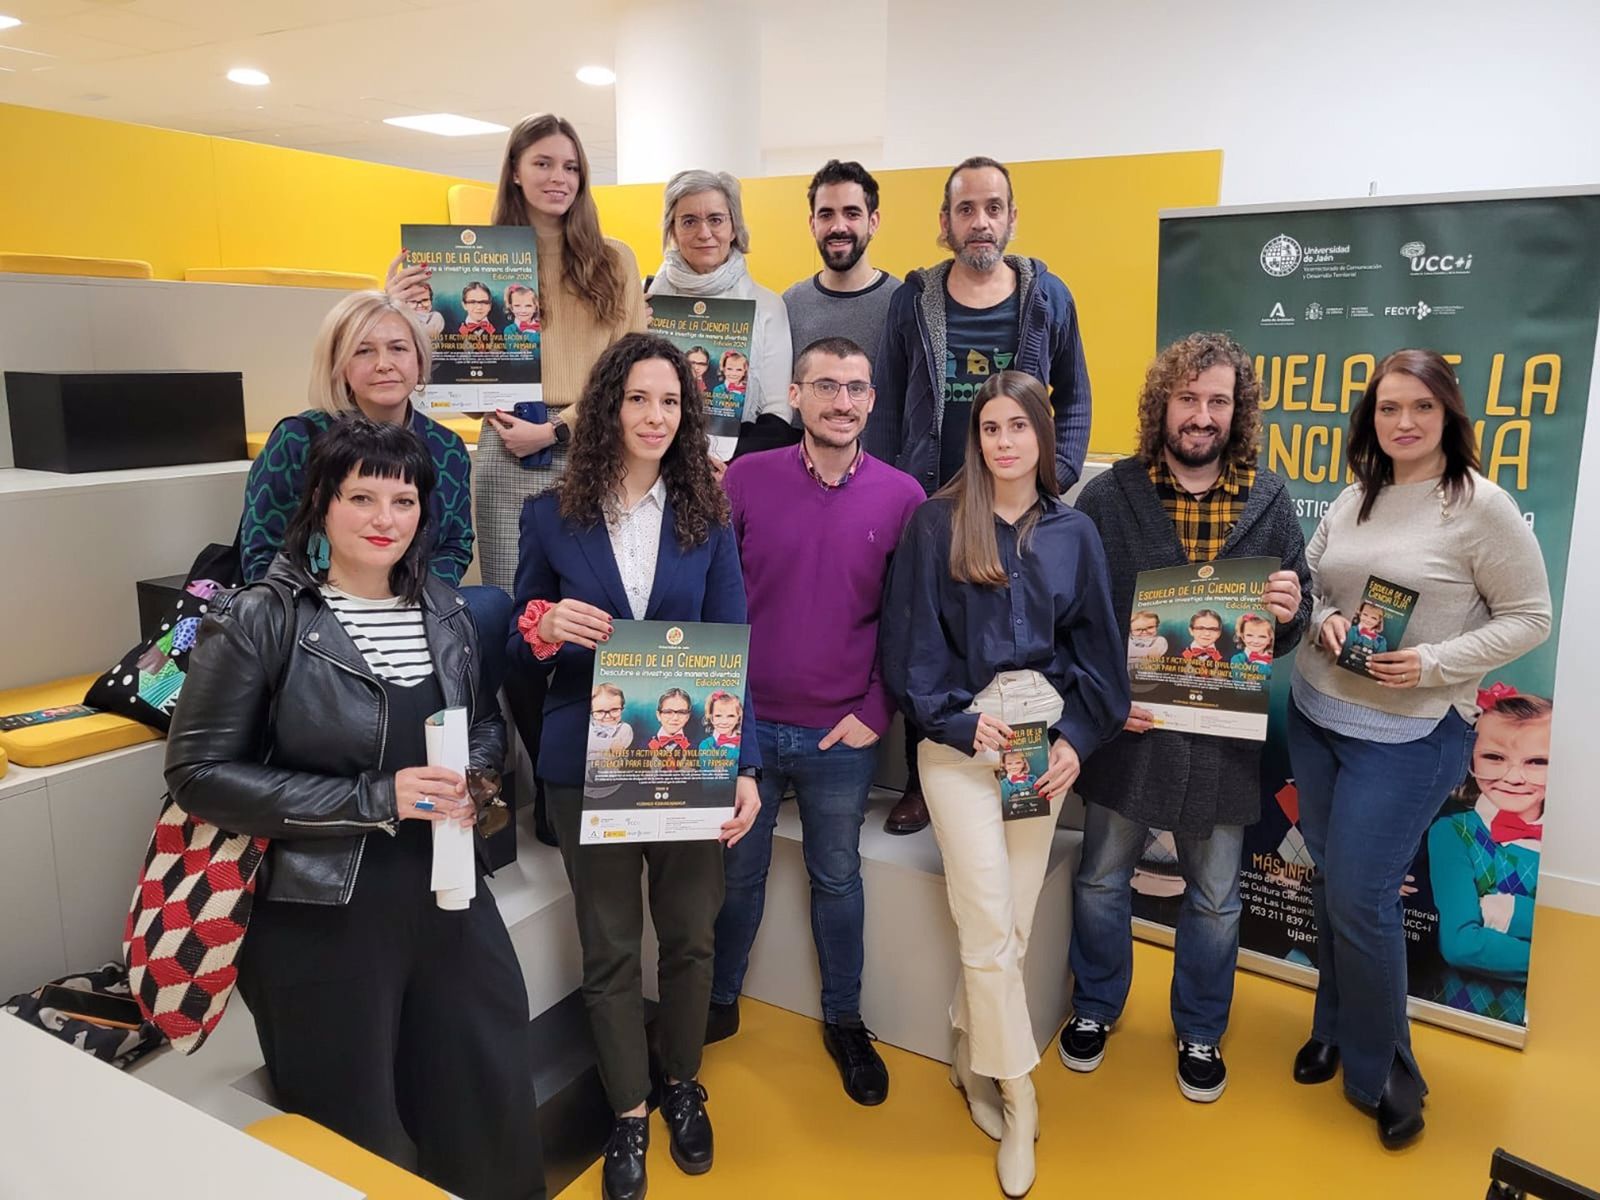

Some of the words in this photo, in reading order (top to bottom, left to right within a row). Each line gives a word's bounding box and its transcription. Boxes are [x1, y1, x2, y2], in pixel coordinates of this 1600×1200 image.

[1304, 244, 1350, 255] Universidad
[445, 252, 456, 264] DE
[459, 252, 471, 264] LA
[473, 251, 508, 265] CIENCIA
[511, 251, 532, 265] UJA
[1303, 255, 1314, 263] de
[1314, 253, 1334, 262] Jaén
[1384, 306, 1418, 316] FECYT
[689, 321, 698, 330] LA
[732, 322, 749, 334] UJA
[1257, 352, 1376, 414] UELA
[1485, 353, 1562, 417] LA
[1138, 587, 1175, 601] ESCUELA
[1178, 586, 1190, 596] DE
[1192, 584, 1205, 595] LA
[1208, 582, 1246, 594] CIENCIA
[1250, 581, 1265, 595] UJ
[601, 650, 642, 667] ESCUELA
[646, 654, 657, 668] DE
[661, 654, 674, 668] LA
[678, 652, 717, 668] CIENCIA
[720, 653, 742, 669] UJA
[600, 668, 634, 676] Descubre
[696, 679, 720, 687] Edición
[1253, 852, 1280, 876] MÁS
[1240, 880, 1249, 889] de
[1251, 883, 1280, 896] Cultura
[1282, 891, 1313, 906] Científic
[1240, 870, 1263, 880] orado
[1264, 876, 1274, 884] de
[1276, 879, 1313, 894] Comunic
[1403, 908, 1438, 922] rritorial
[1252, 894, 1262, 903] de
[1264, 897, 1279, 908] Las
[1250, 904, 1266, 917] 953
[1268, 910, 1283, 921] 211
[1286, 915, 1303, 926] 839
